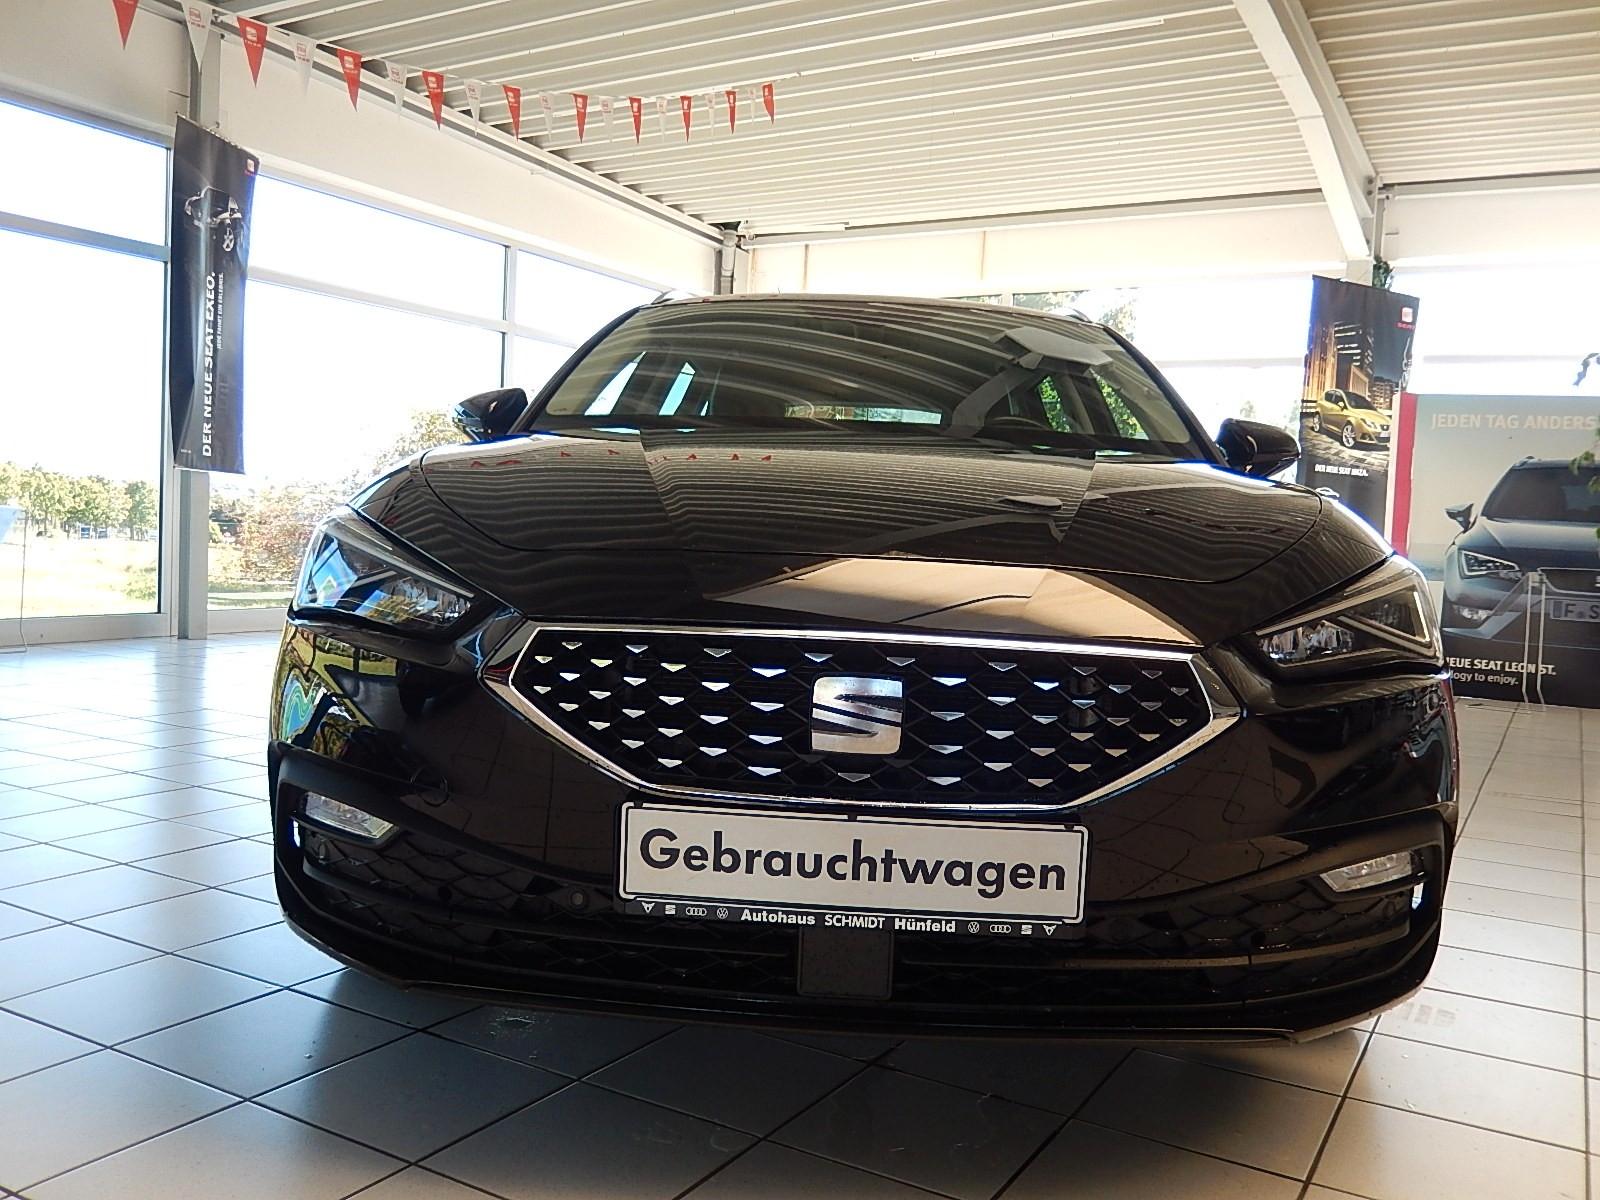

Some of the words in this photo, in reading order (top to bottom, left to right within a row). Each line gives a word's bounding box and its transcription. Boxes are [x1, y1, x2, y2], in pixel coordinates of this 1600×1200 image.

[206, 271, 216, 321] EXEO.
[204, 321, 214, 369] SEAT
[203, 372, 213, 418] NEUE
[1431, 413, 1480, 430] JEDEN
[1485, 414, 1519, 429] TAG
[1523, 415, 1599, 430] ANDERS
[202, 422, 212, 457] DER
[1473, 659, 1503, 671] SEAT
[1504, 661, 1537, 674] LEON
[1538, 664, 1557, 676] ST.
[1474, 672, 1486, 682] to
[1487, 674, 1519, 686] enjoy.
[639, 827, 1066, 899] Gebrauchtwagen
[740, 908, 816, 926] Autohaus
[824, 914, 885, 930] SCHMIDT
[894, 917, 956, 934] Hünfeld
